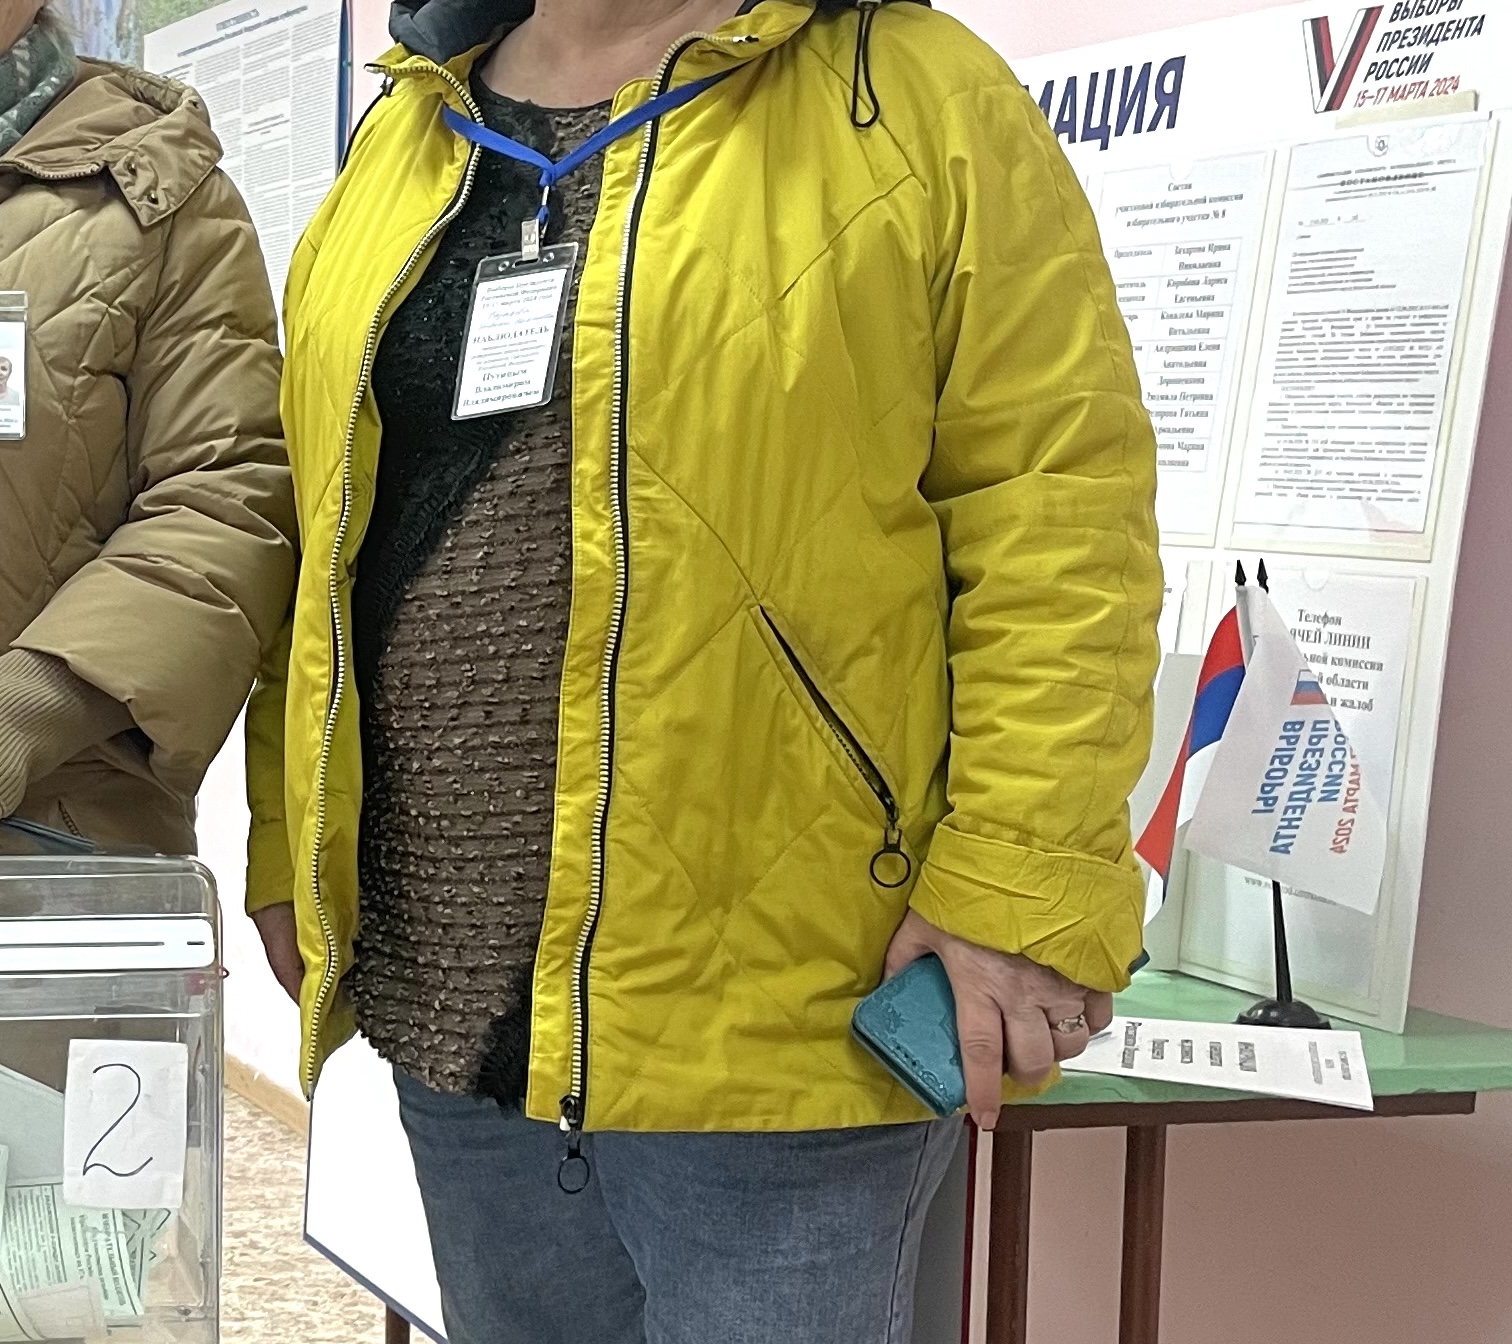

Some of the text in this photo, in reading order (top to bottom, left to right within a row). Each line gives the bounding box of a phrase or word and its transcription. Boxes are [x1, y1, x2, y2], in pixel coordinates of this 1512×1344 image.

[1376, 14, 1486, 53] ПРЕЗИДЕНТА
[1363, 52, 1434, 83] РОССИИ
[1387, 80, 1429, 103] МАРТА
[1429, 75, 1461, 97] 2024
[1298, 609, 1342, 628] Телефон
[1324, 633, 1371, 649] ЛИНИИ
[1331, 656, 1384, 672] комиссии
[1326, 674, 1369, 690] области
[1340, 698, 1374, 712] жалоб
[83, 1063, 153, 1177] 2
